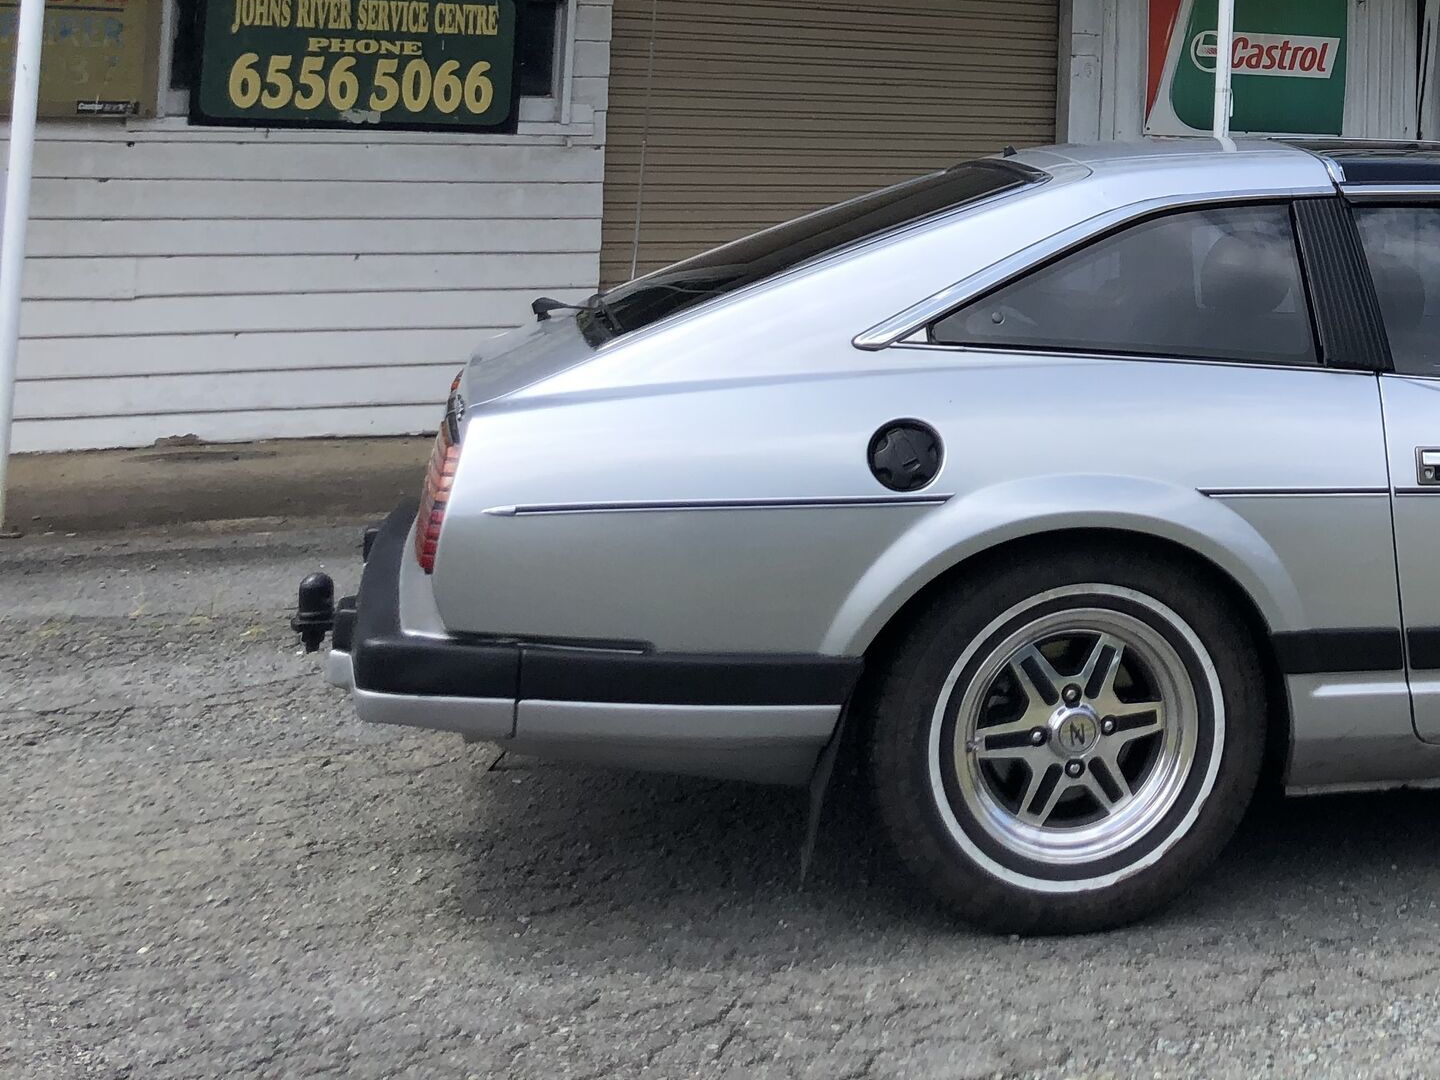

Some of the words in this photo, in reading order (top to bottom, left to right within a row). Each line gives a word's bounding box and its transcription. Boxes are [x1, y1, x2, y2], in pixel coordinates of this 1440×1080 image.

[434, 1, 499, 36] CENTRE
[306, 37, 423, 56] PHONE
[1231, 36, 1330, 72] Castrol
[228, 52, 360, 112] 6556
[368, 57, 494, 114] 5066
